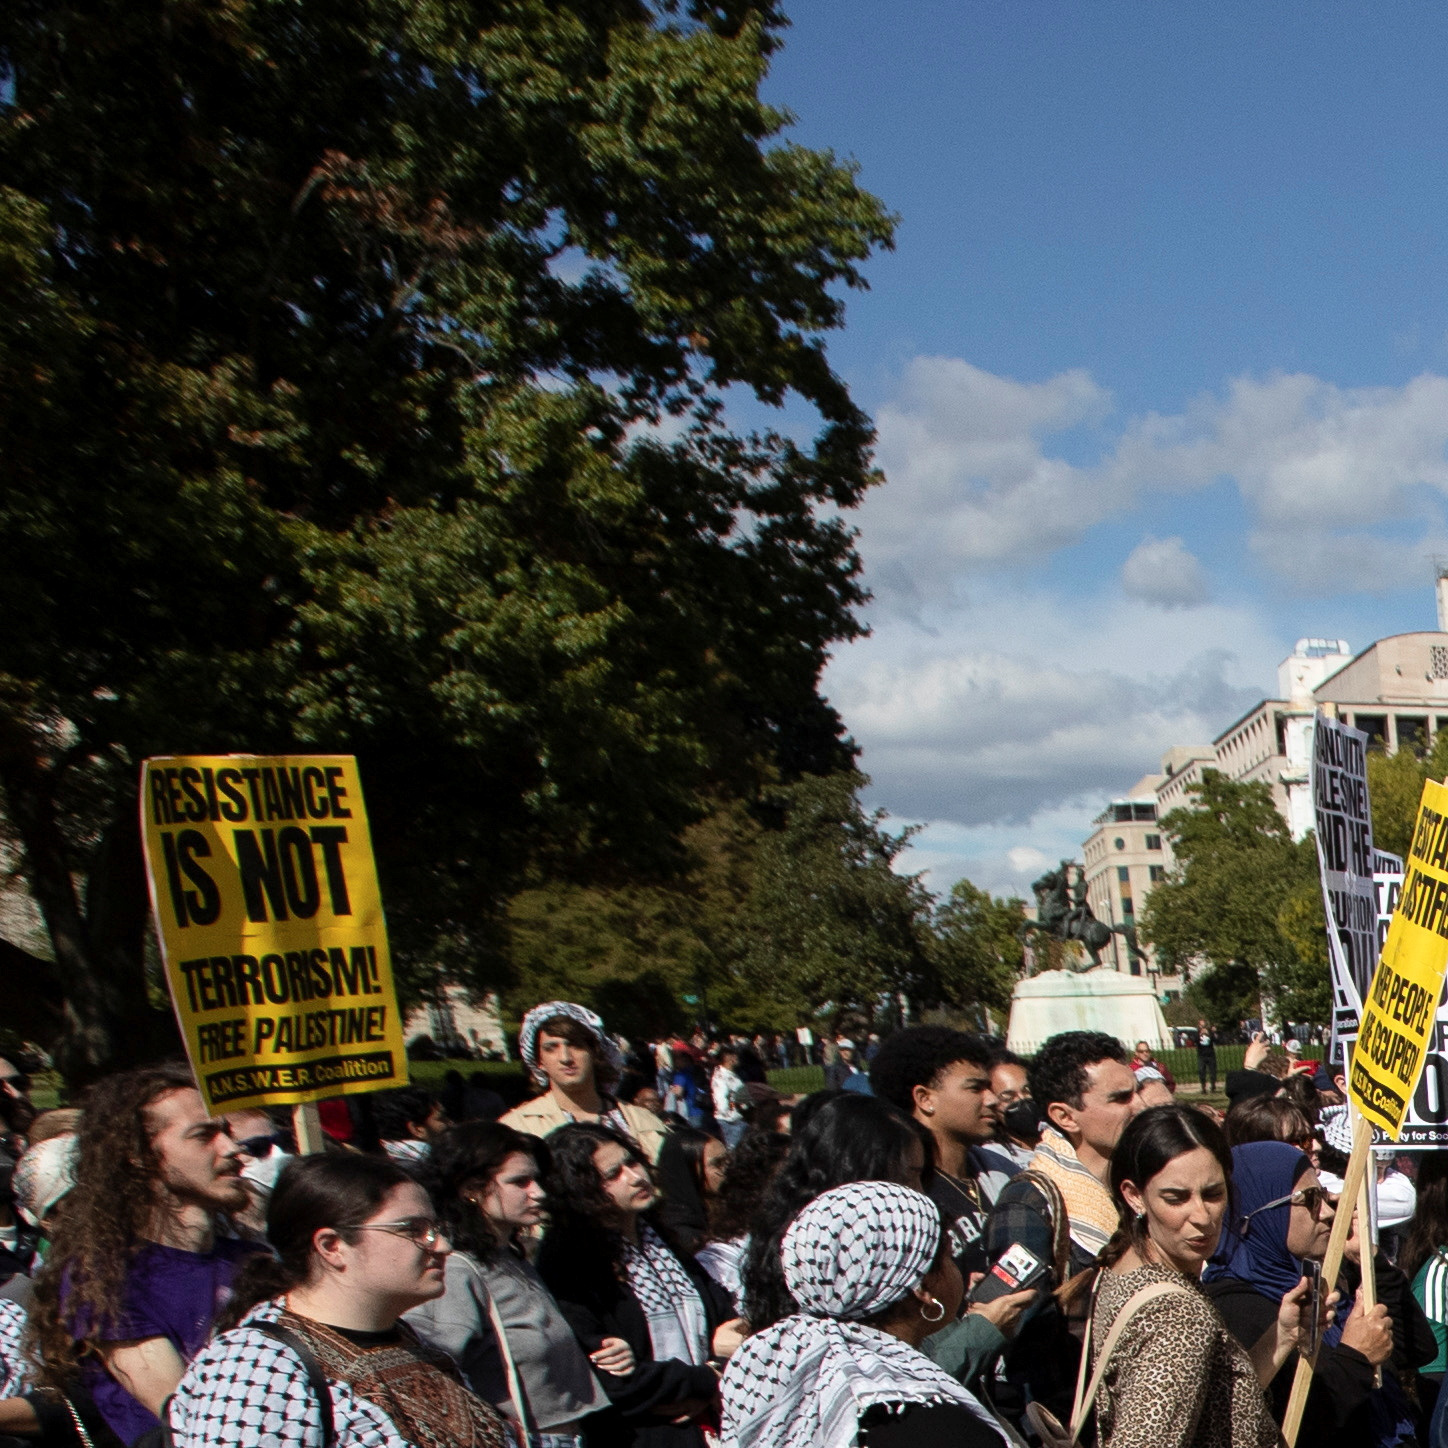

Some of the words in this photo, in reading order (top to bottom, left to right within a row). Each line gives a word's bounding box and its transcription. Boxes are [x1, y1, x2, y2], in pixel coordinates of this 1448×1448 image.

[149, 766, 352, 825] RESISTANCE
[161, 829, 221, 928] IS
[233, 825, 353, 923] NOT
[180, 945, 382, 1013] TERRORISM!
[1390, 973, 1434, 1037] PEOPLE
[197, 1018, 246, 1064] FREE
[253, 1004, 386, 1055] PALESTINE!
[315, 1058, 389, 1082] Coalition
[1412, 1130, 1427, 1141] for
